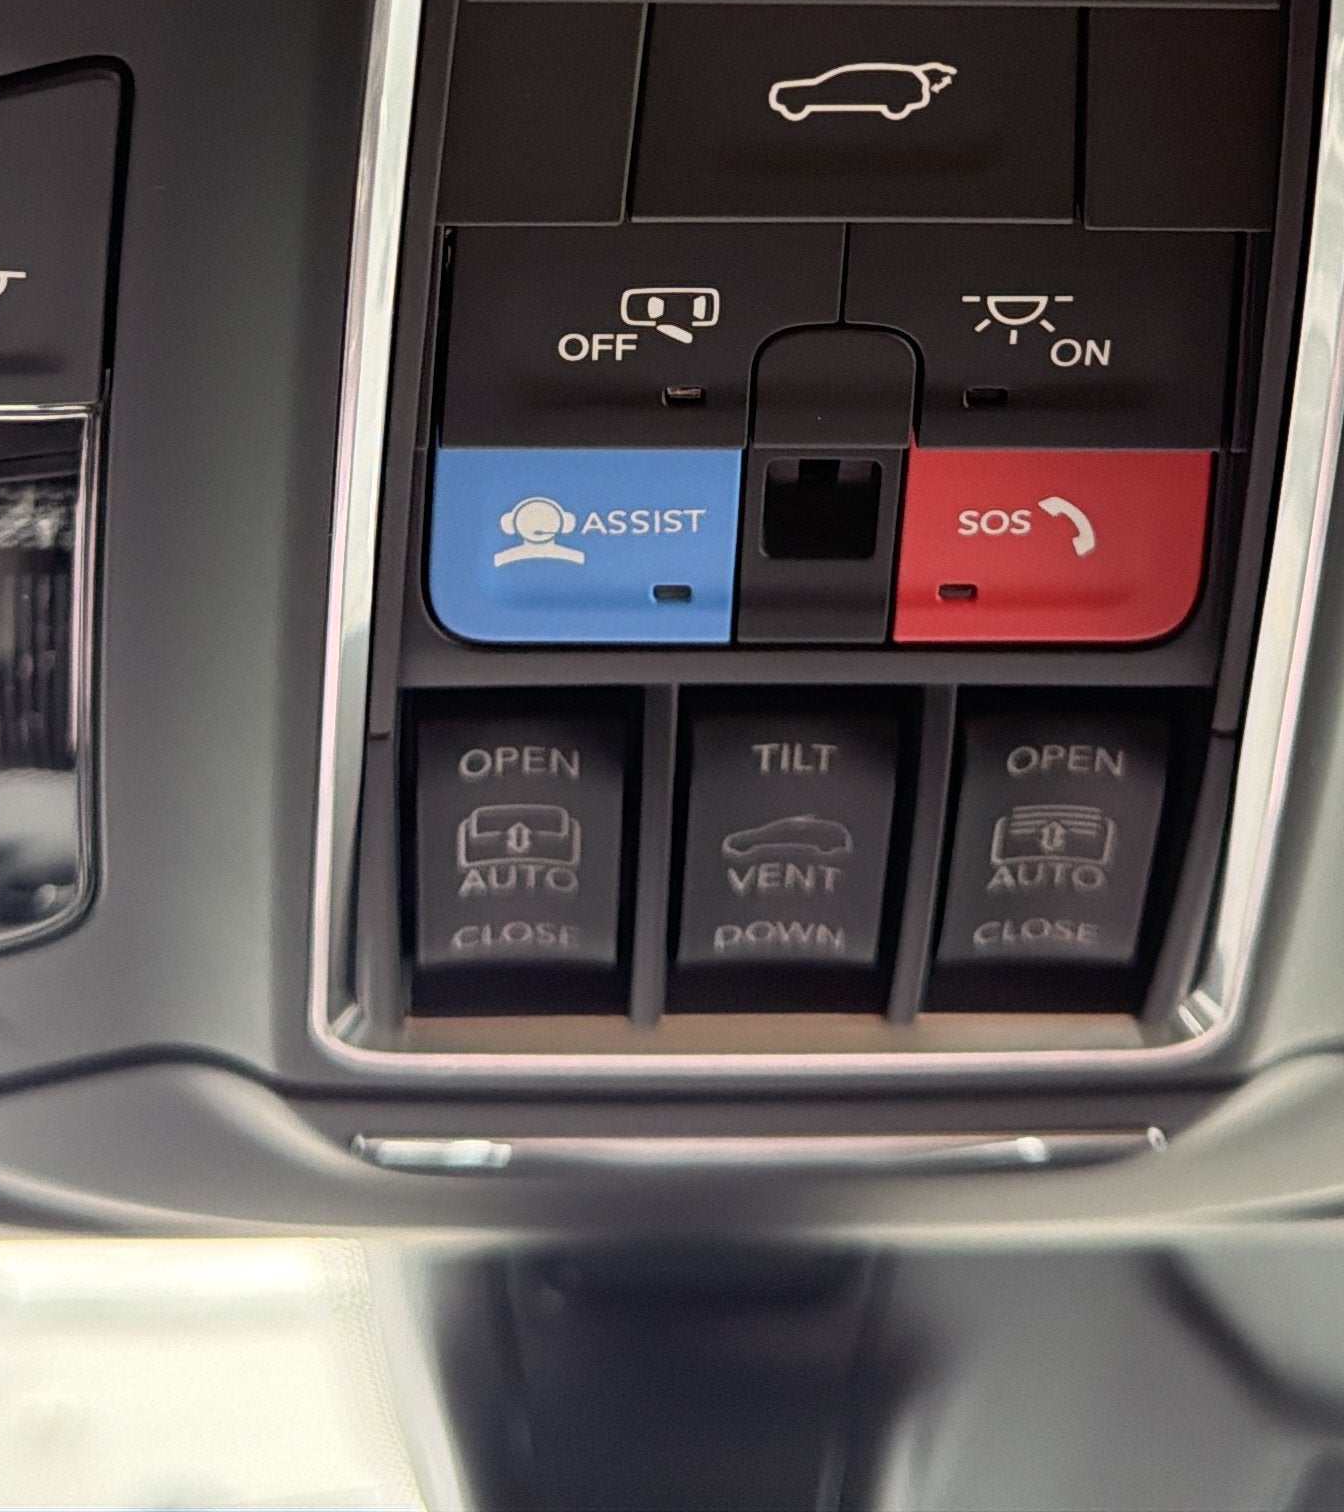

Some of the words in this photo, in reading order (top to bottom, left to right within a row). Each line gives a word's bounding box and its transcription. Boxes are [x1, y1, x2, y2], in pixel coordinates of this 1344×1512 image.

[558, 334, 638, 362] OFF
[1050, 339, 1112, 367] ON
[581, 509, 706, 537] ASSIST
[957, 510, 1032, 537] SOS
[459, 746, 580, 780] OPEN
[752, 743, 838, 774] TILT
[1006, 745, 1126, 778] OPEN
[459, 866, 580, 895] AUTO
[727, 864, 843, 894] VENT
[987, 864, 1106, 892] AUTO
[452, 921, 580, 950] CLOSE
[713, 921, 845, 951] DOWN
[974, 918, 1099, 946] CLOSE
